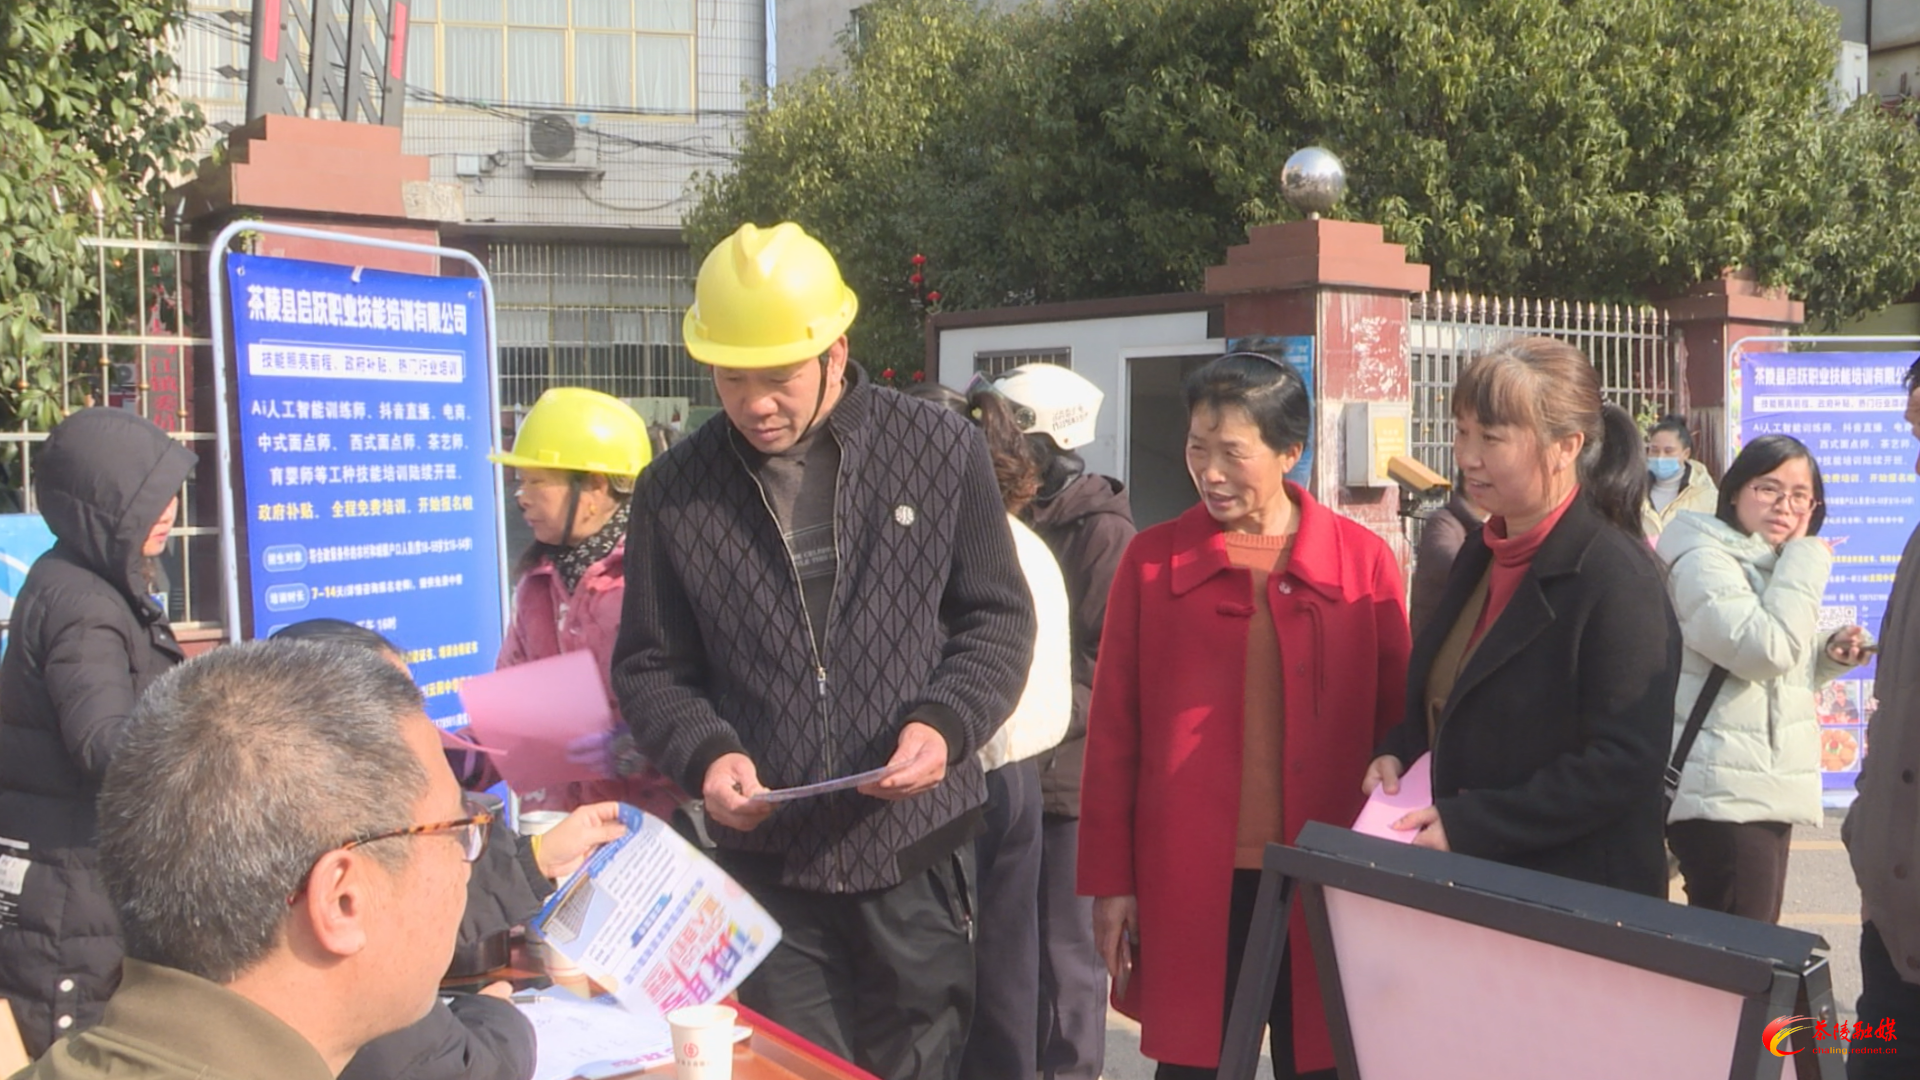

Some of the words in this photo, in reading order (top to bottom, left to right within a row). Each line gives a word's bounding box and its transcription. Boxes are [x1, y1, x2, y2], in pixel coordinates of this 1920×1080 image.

[248, 284, 467, 335] 茶陵县启跃职业技能培训有限公司
[1754, 366, 1908, 386] 茶陵县启跃职业技能培训有限公
